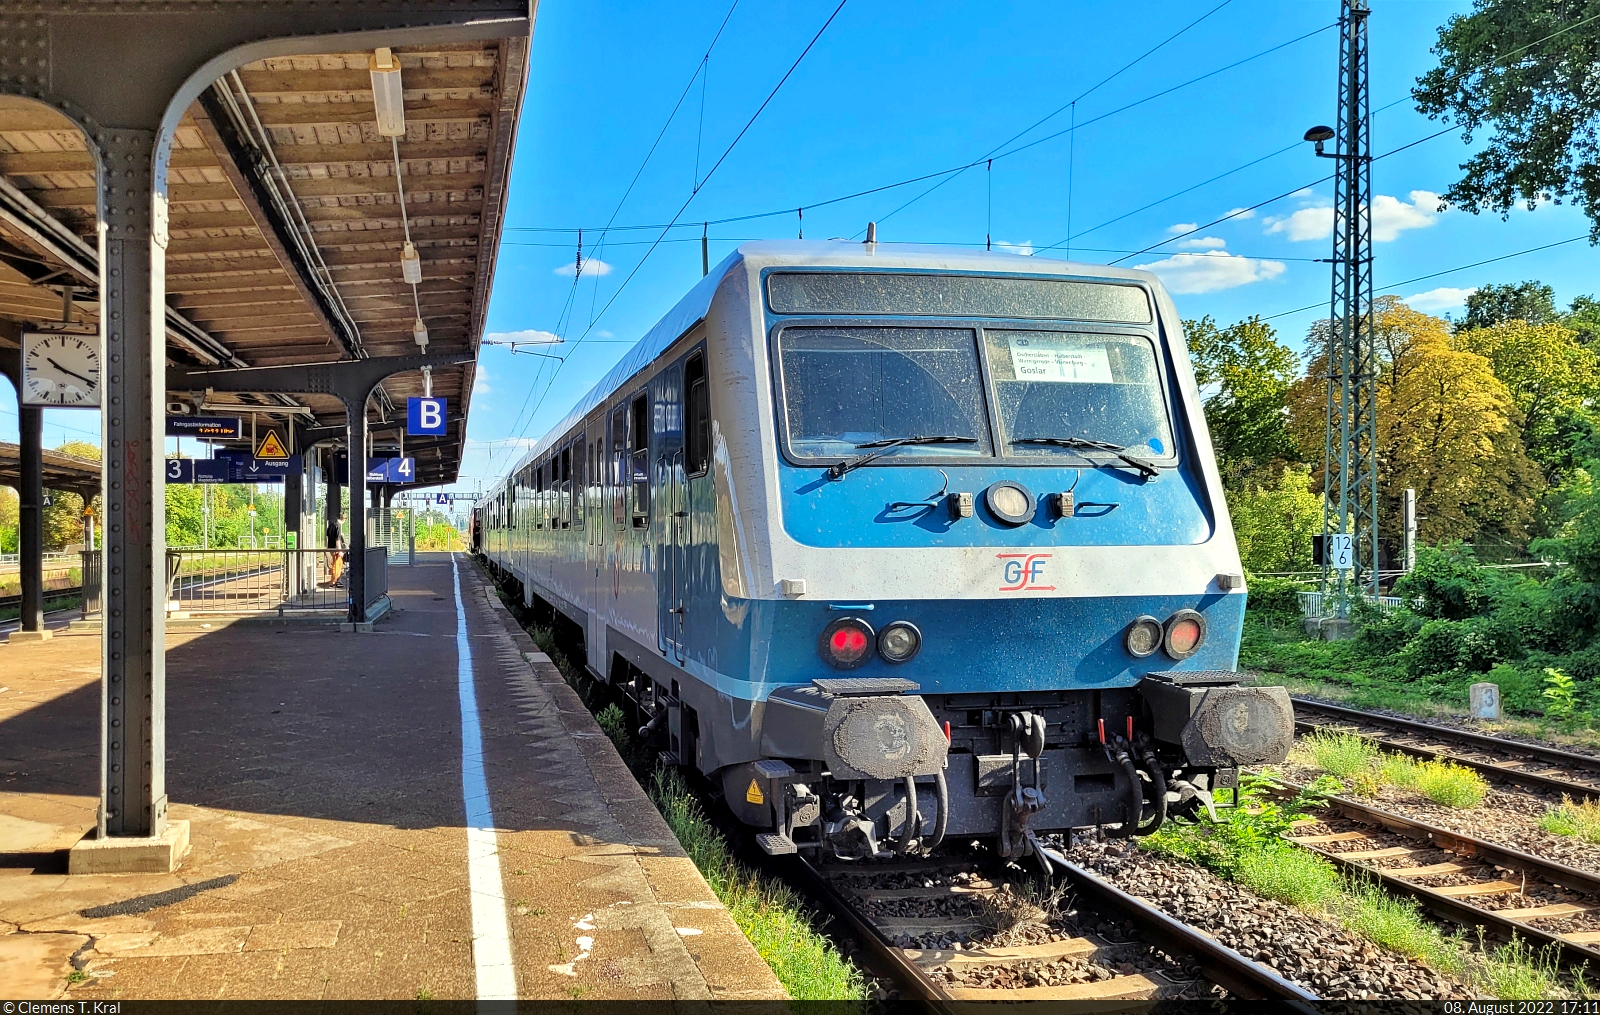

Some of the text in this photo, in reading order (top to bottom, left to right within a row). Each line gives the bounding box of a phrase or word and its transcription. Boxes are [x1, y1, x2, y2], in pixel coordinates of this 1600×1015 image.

[1020, 366, 1047, 375] Goslar
[420, 400, 442, 429] B
[173, 421, 222, 429] Fahrgastinformation
[168, 459, 182, 479] 3
[264, 460, 289, 468] Ausgang
[398, 458, 411, 477] 4
[43, 496, 51, 506] A
[439, 494, 446, 503] A
[1335, 536, 1351, 550] 12
[1339, 551, 1347, 565] 6
[1484, 688, 1494, 708] 3
